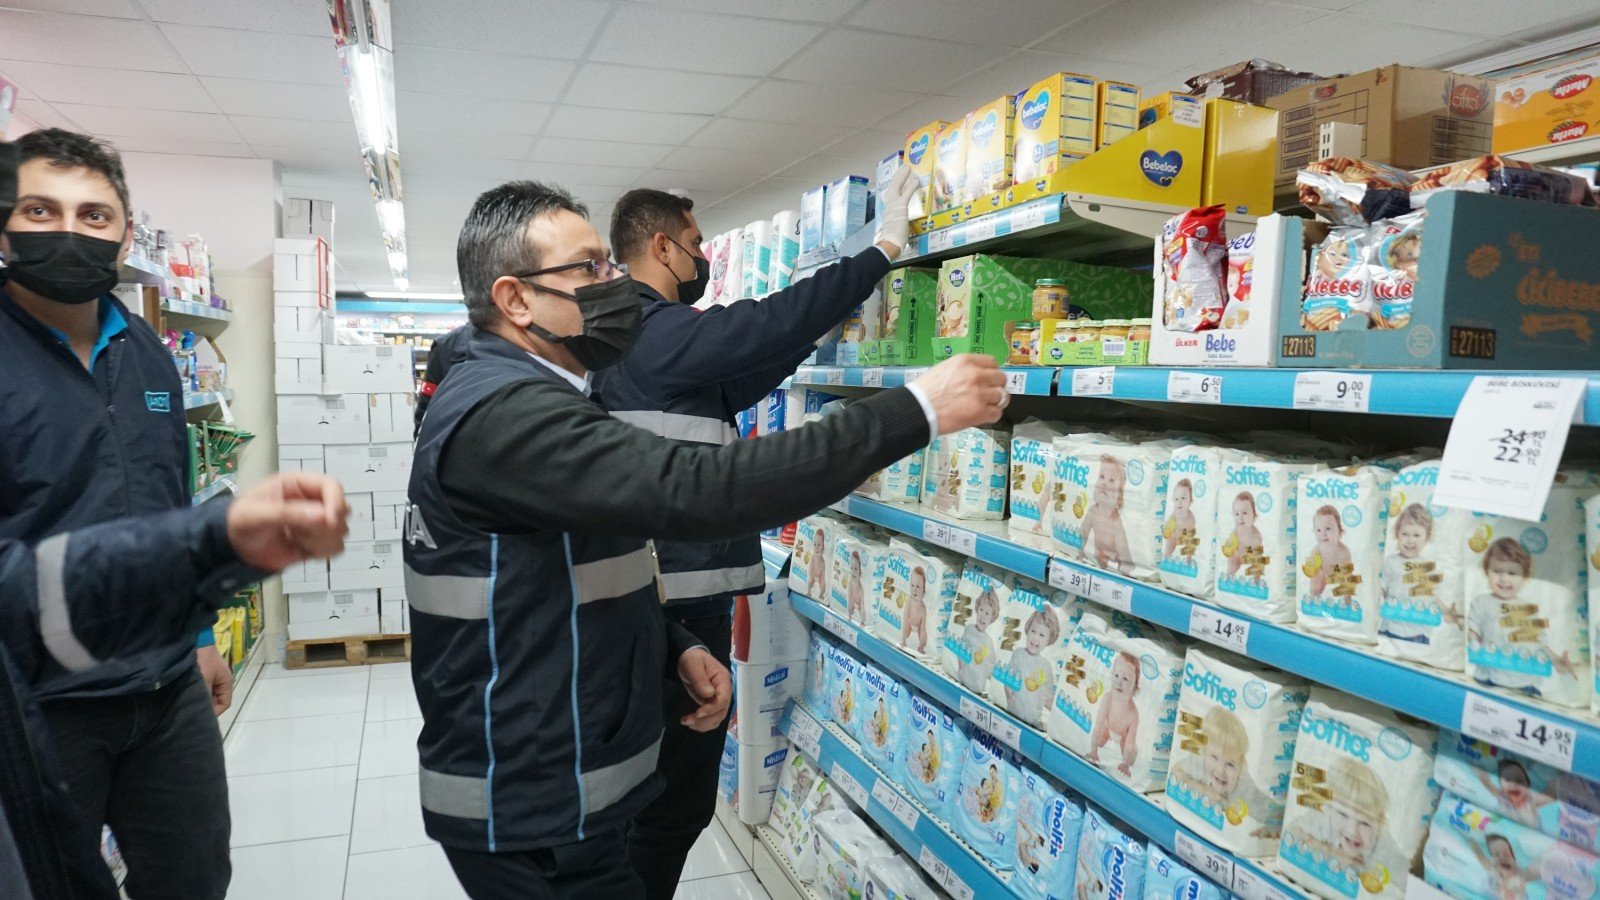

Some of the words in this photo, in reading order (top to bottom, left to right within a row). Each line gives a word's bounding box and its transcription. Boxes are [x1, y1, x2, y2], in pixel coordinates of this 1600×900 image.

[1022, 100, 1048, 118] bebelac
[1142, 156, 1179, 174] Bebelac
[1175, 337, 1198, 347] ÜLKER
[1205, 333, 1236, 352] Bebe
[1288, 337, 1315, 356] 27113
[1458, 330, 1495, 357] 27113
[834, 652, 854, 675] molfix
[865, 669, 886, 693] molfix
[912, 699, 938, 727] molfix
[973, 726, 1004, 760] molfix
[1050, 799, 1065, 858] molfix
